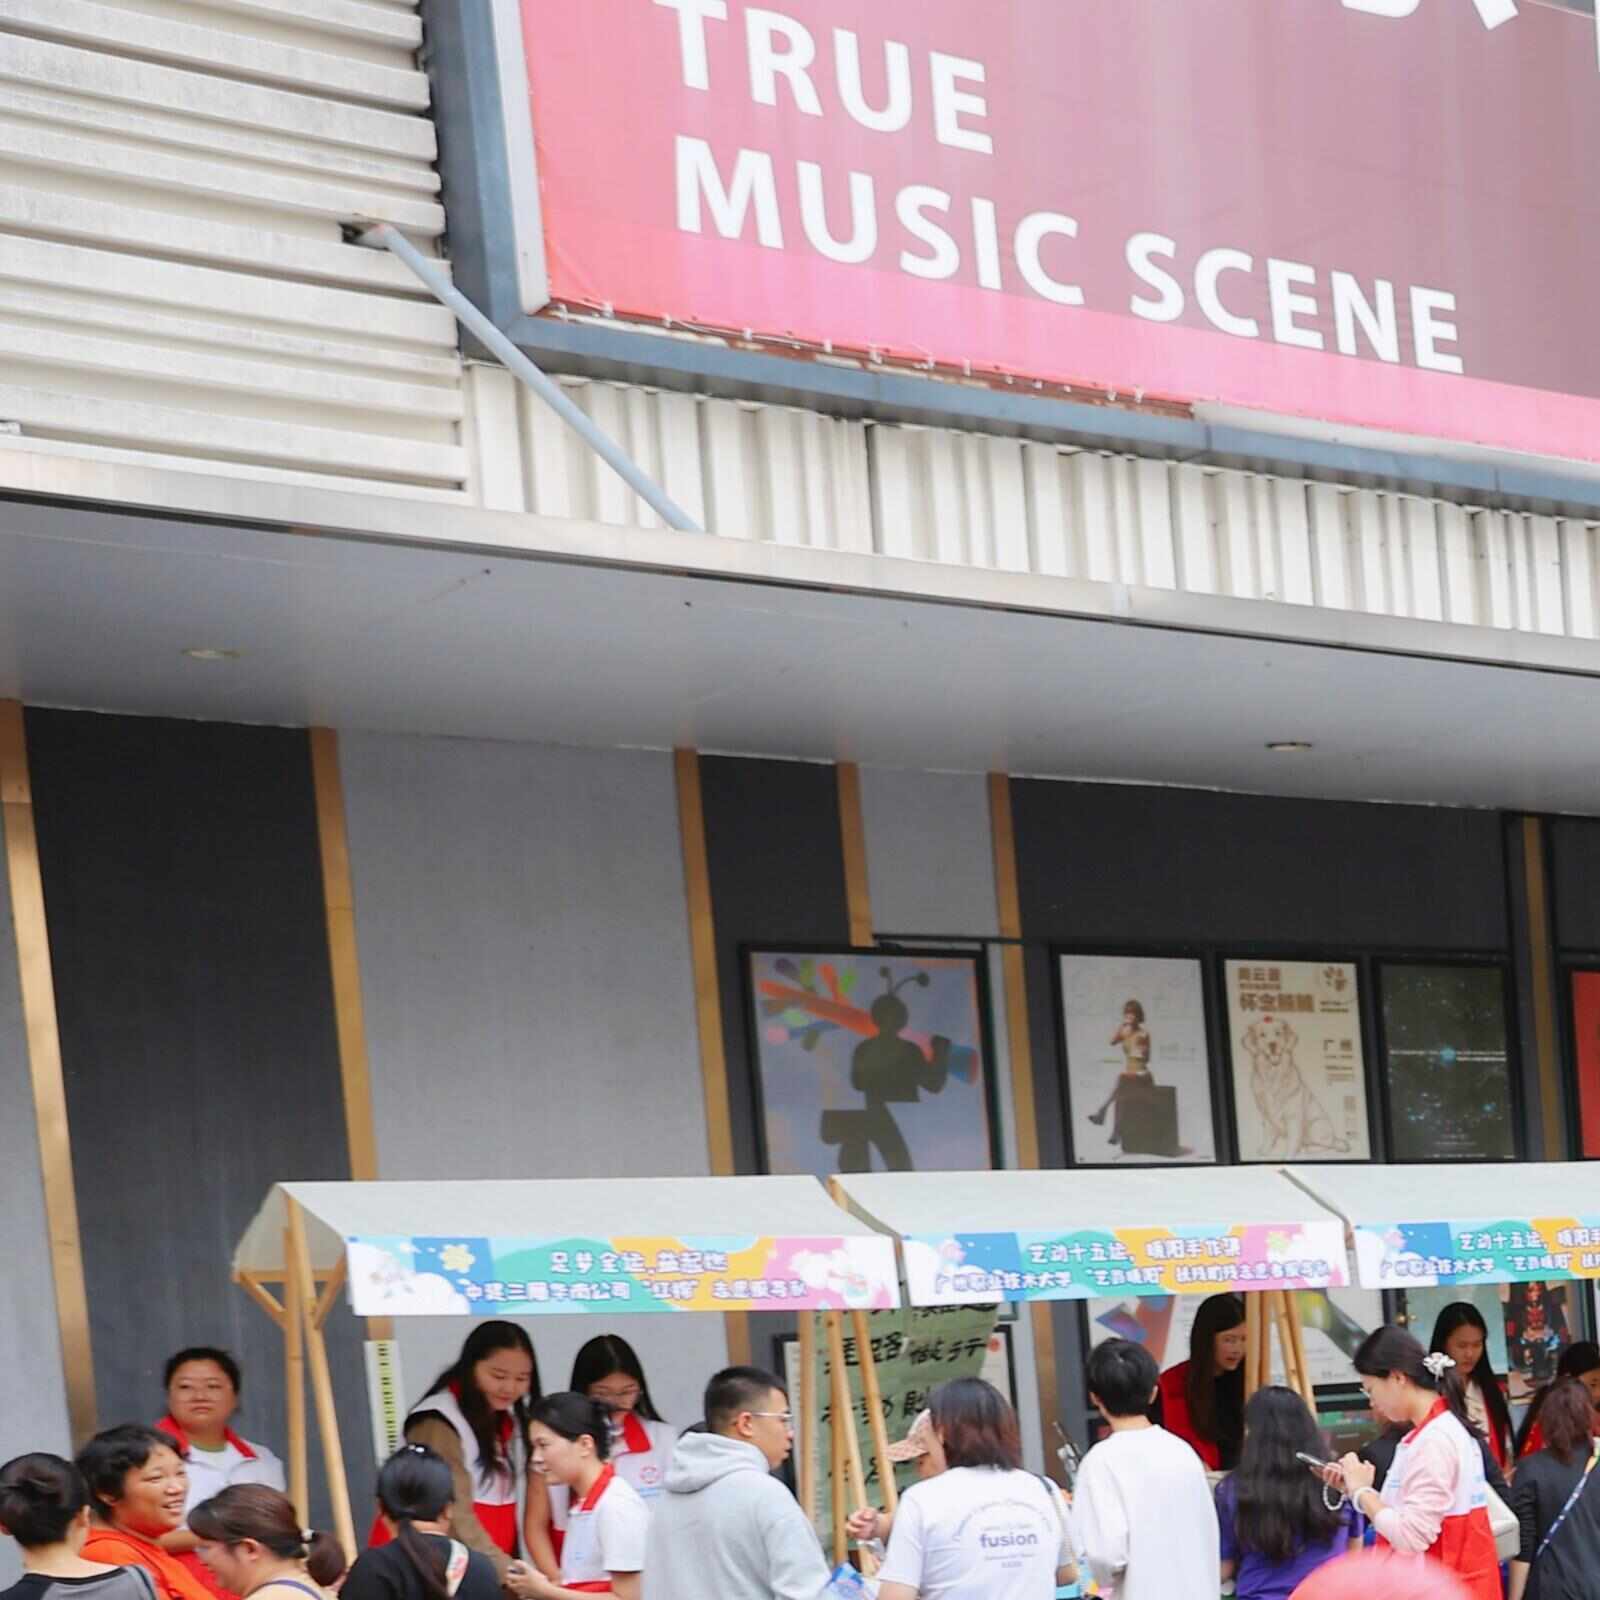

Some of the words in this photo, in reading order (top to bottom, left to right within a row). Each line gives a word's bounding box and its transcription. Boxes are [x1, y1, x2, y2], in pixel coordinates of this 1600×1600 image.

[653, 0, 994, 155] TRUE
[674, 135, 1085, 306] MUSIC
[1126, 232, 1465, 375] SCENE
[980, 1531, 1039, 1548] fusion
